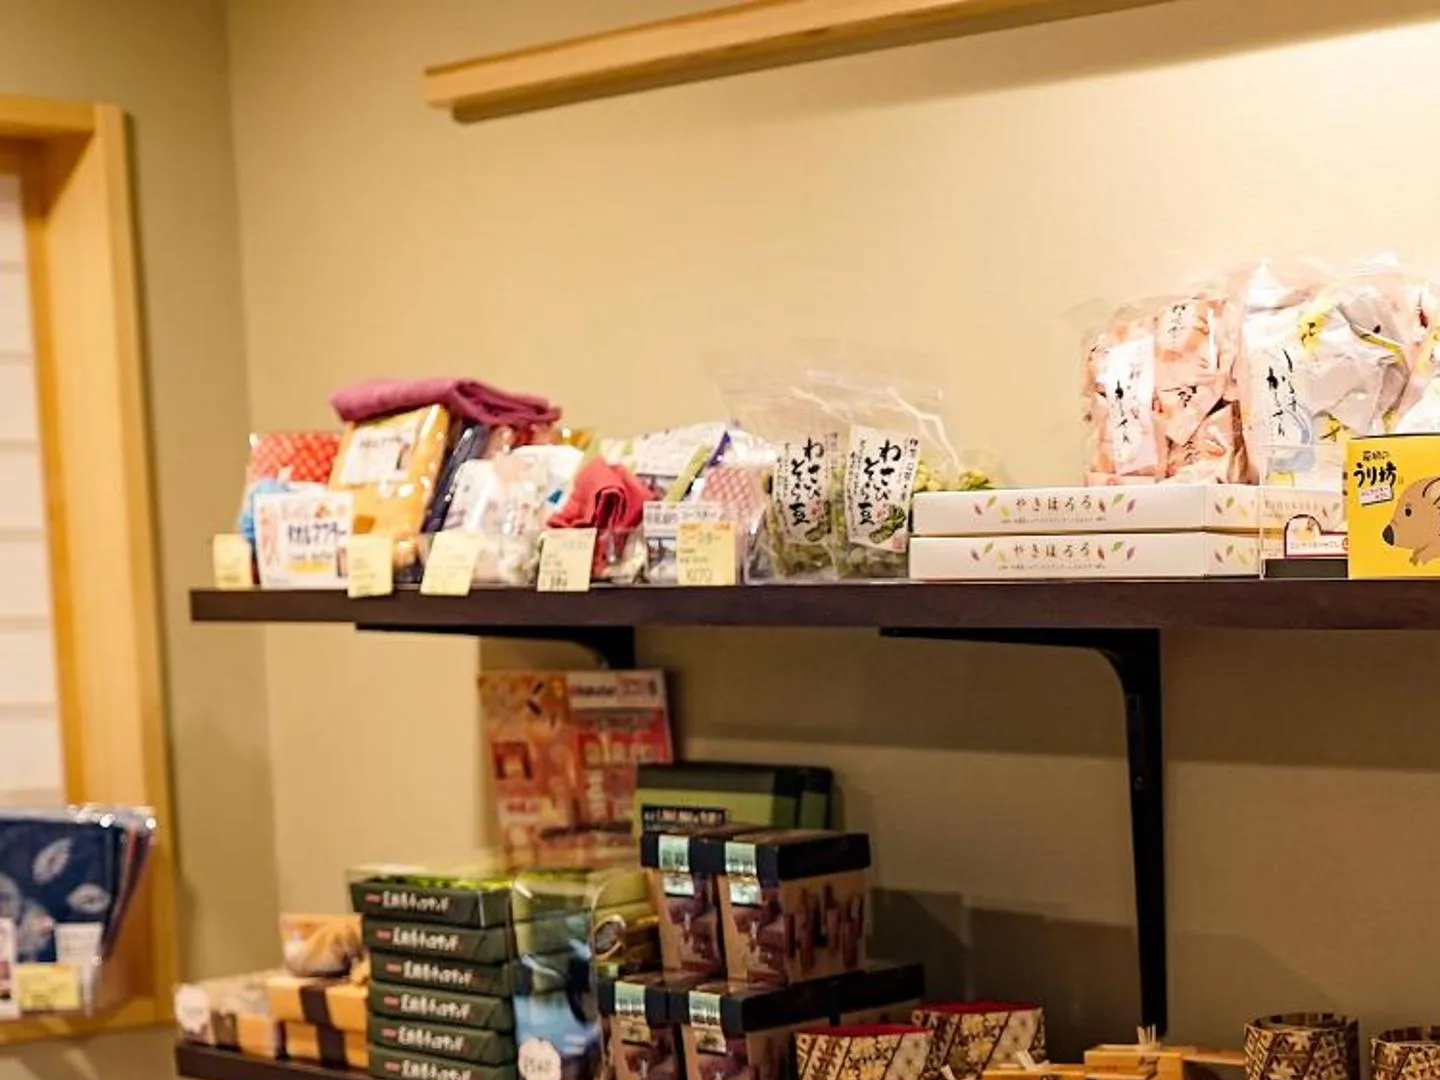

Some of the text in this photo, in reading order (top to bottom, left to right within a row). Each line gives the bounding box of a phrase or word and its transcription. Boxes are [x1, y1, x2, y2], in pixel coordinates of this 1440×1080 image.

[1353, 462, 1396, 487] うり坊
[1016, 494, 1091, 511] やきほろろ
[1014, 542, 1089, 558] やきほろろ
